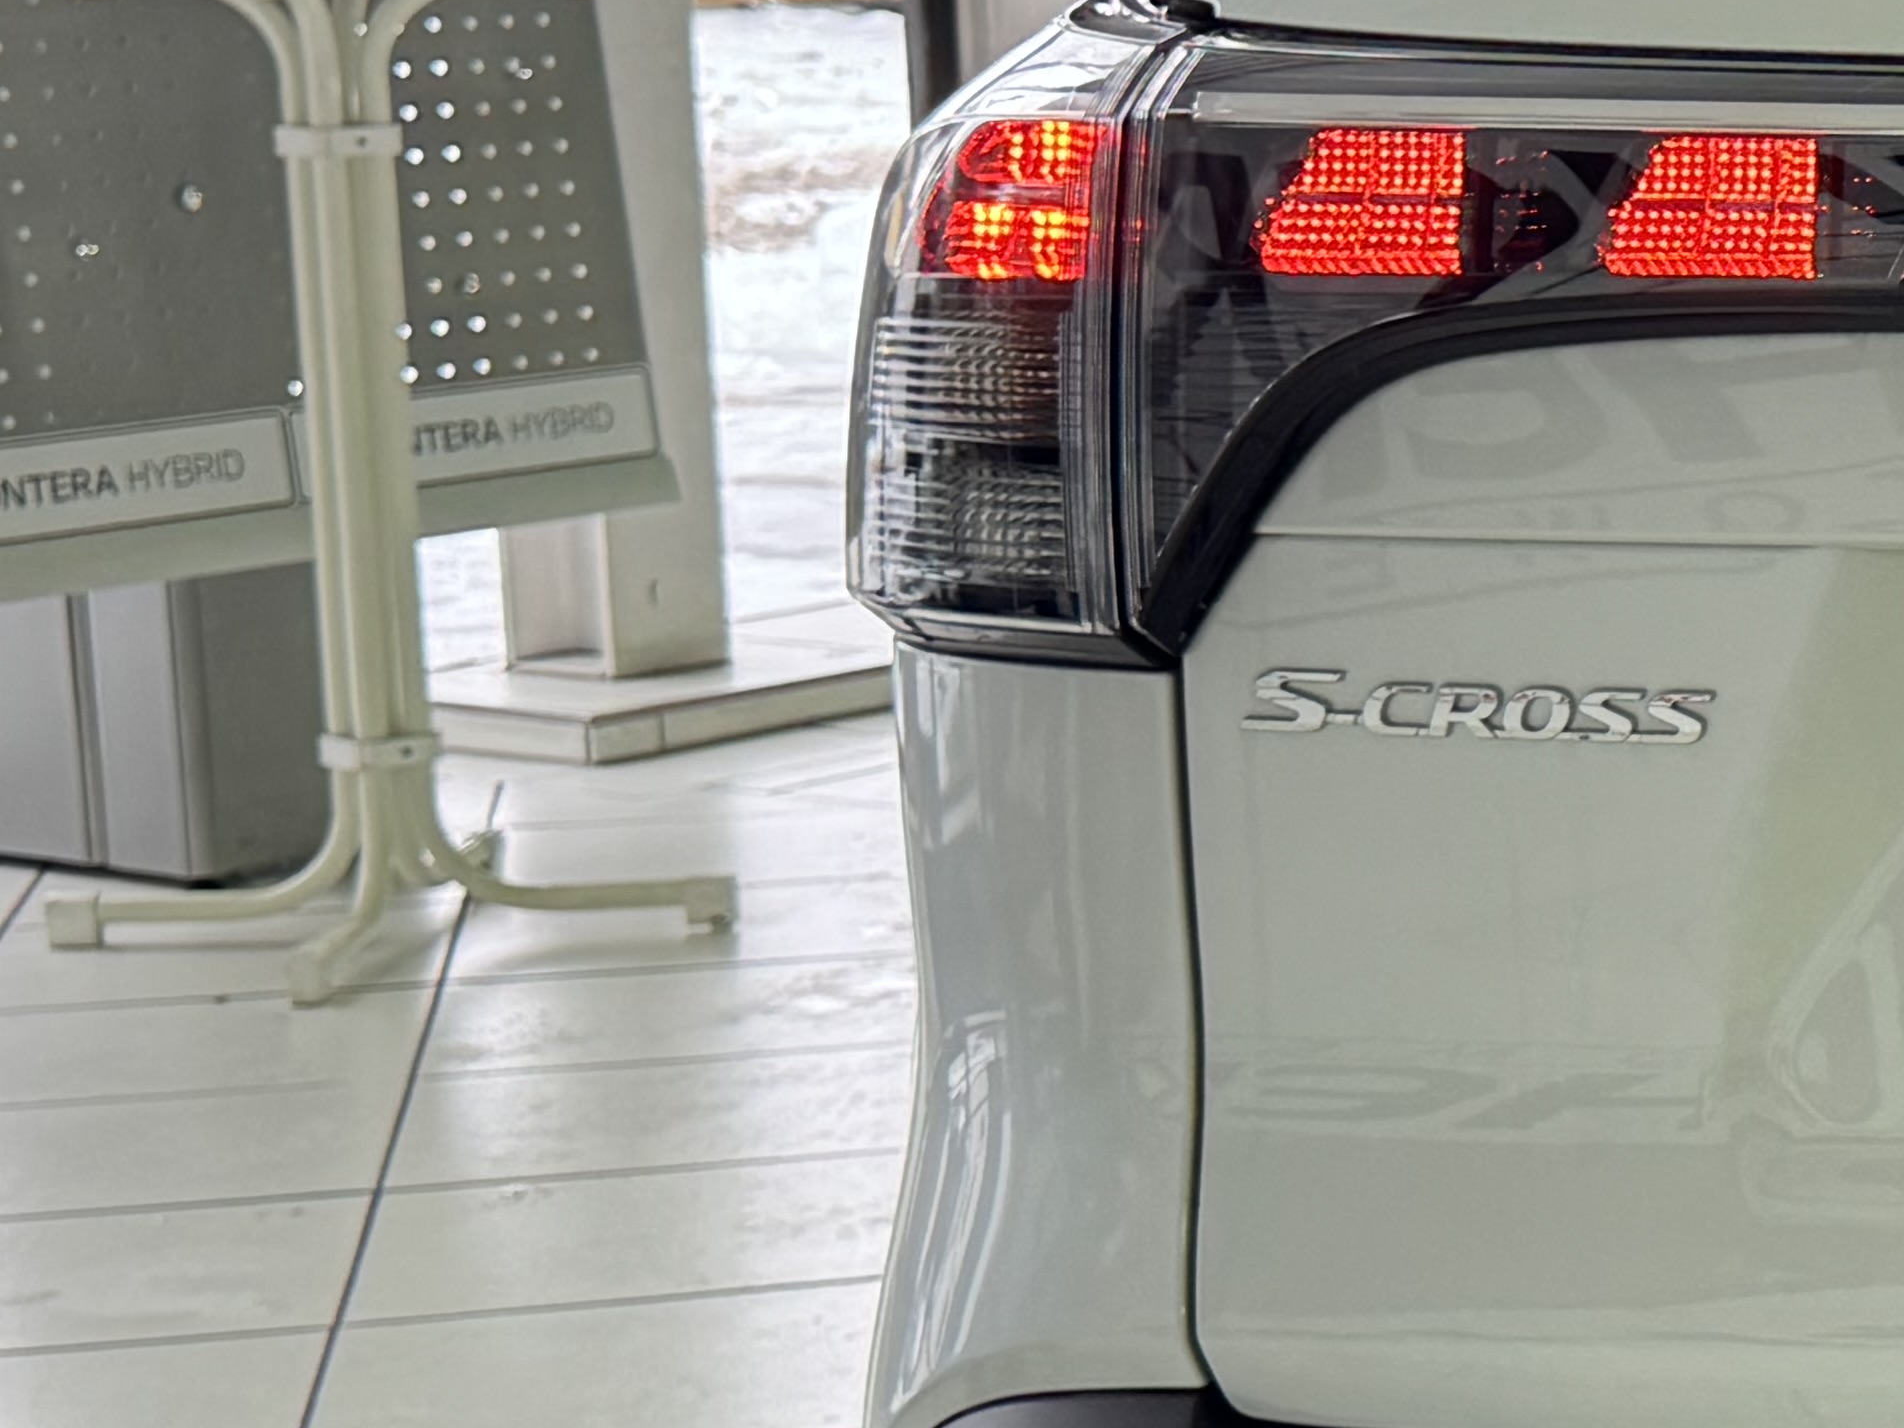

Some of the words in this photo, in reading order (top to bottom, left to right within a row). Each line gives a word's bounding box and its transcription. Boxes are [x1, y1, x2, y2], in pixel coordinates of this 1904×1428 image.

[509, 401, 619, 444] HYBRID
[126, 448, 247, 493] HYBRID
[1240, 668, 1716, 745] S-CROSS
